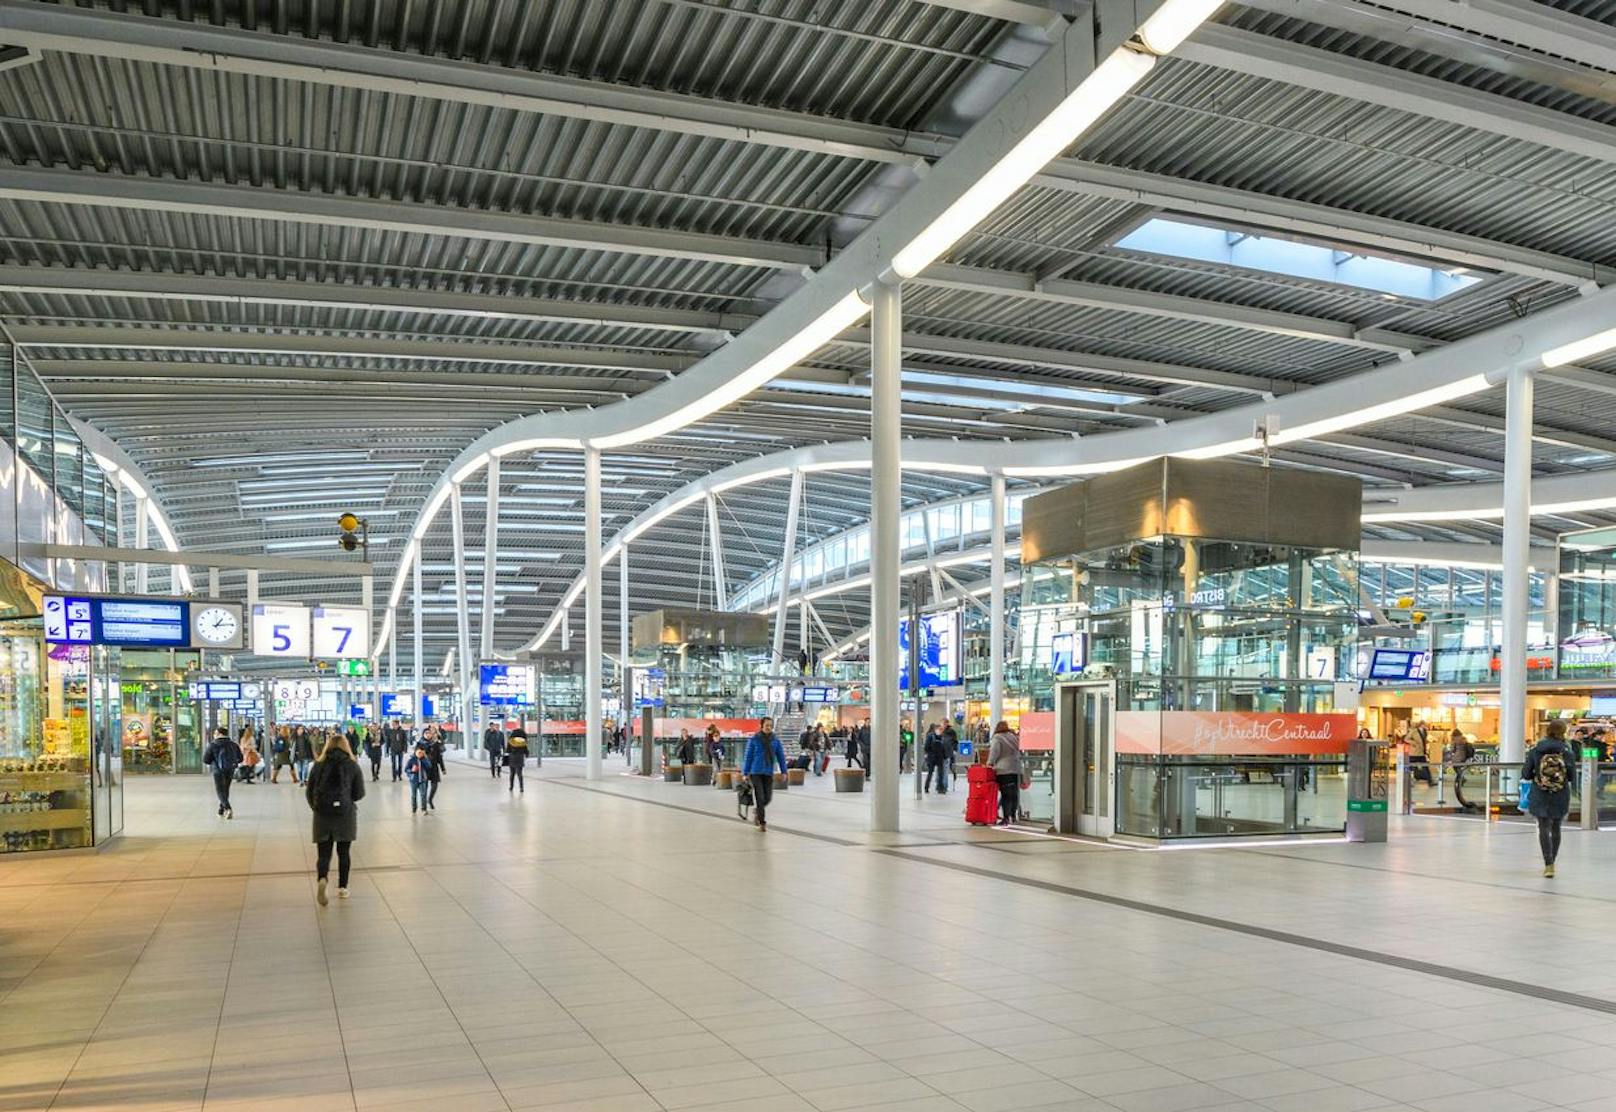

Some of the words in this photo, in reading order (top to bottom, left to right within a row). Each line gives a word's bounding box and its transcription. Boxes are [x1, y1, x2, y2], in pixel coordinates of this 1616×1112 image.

[272, 624, 292, 652] 5
[332, 627, 352, 654] 7
[1317, 658, 1327, 678] 7
[281, 687, 289, 699] 8
[304, 687, 312, 699] 9
